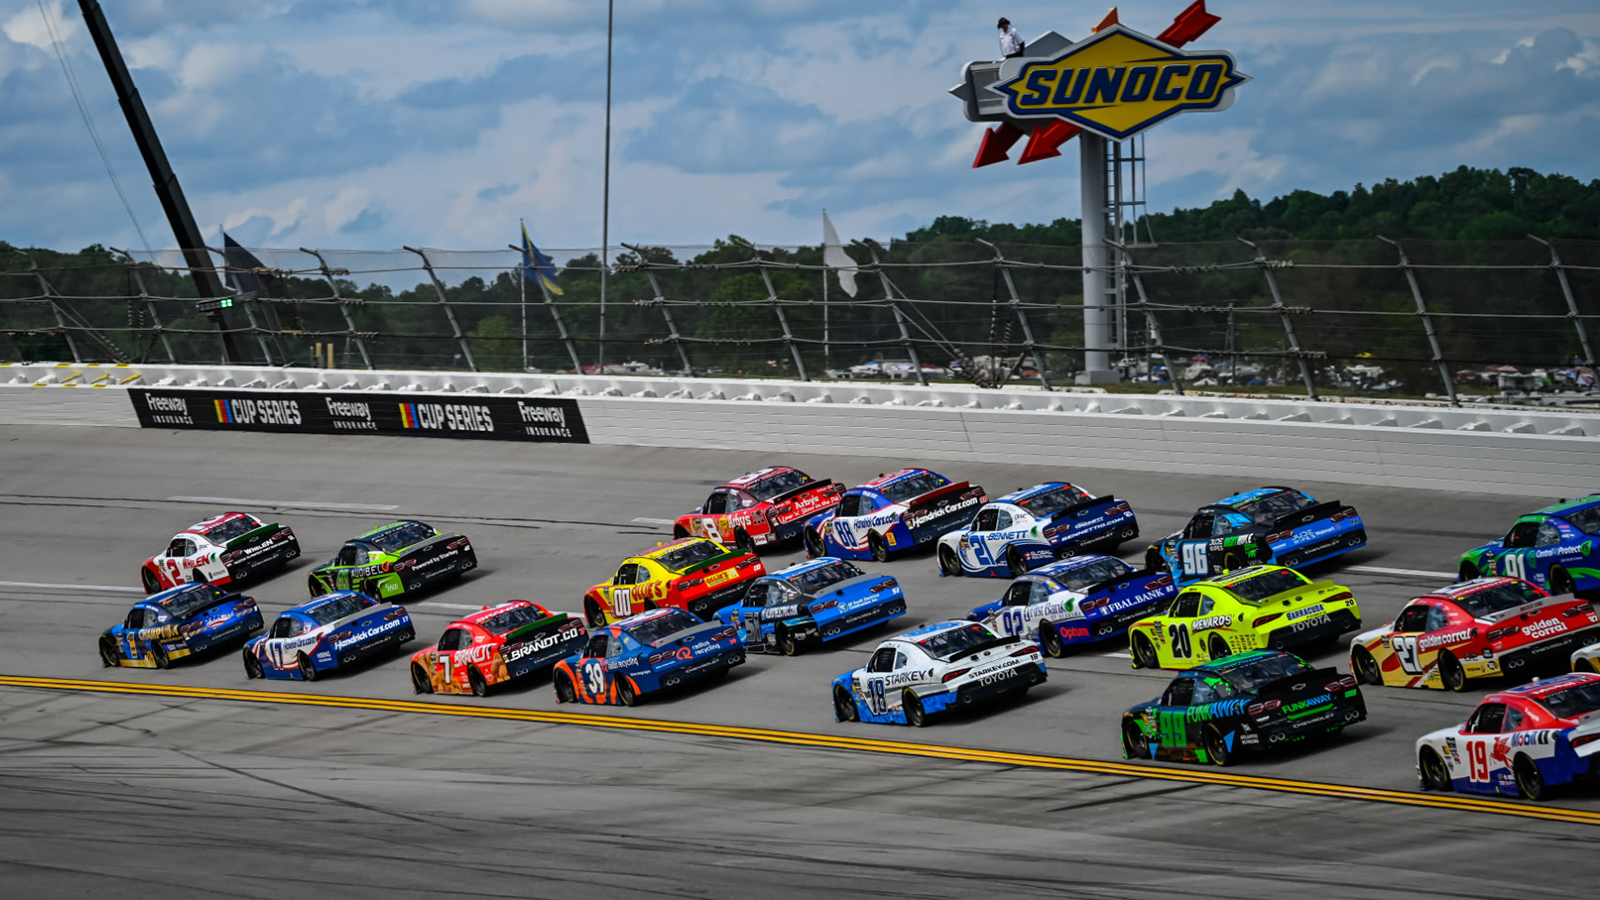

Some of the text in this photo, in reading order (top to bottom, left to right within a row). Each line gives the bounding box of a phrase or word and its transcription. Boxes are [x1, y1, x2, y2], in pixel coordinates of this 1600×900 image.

[1020, 63, 1224, 106] SUNOCO
[145, 393, 187, 415] Freeway
[231, 399, 302, 425] CUP SERIES
[325, 397, 371, 420] Freeway
[517, 401, 566, 427] Freeway
[152, 415, 194, 425] INSURANCE
[333, 420, 379, 431] INSURANCE
[417, 403, 494, 432] CUP SERIES
[525, 427, 572, 438] INSURANCE
[795, 495, 819, 510] Arby's
[912, 497, 978, 528] HendrickCars.com
[702, 517, 723, 543] 8
[728, 511, 752, 530] Arby's
[243, 538, 274, 554] WHELEN
[834, 521, 858, 547] 88
[988, 530, 1029, 540] BENNETT
[969, 535, 996, 565] 21
[1182, 542, 1208, 575] 96
[166, 559, 186, 586] 2
[614, 588, 632, 617] 00
[1286, 604, 1325, 621] BARRACUDA
[1345, 599, 1355, 607] 20
[334, 619, 400, 651] HendrickCars.com
[744, 612, 762, 642] 51
[1060, 626, 1090, 640] Optum
[1192, 614, 1232, 632] MENARDS
[1290, 614, 1331, 632] TOYOTA
[1521, 617, 1560, 636] golden
[1531, 622, 1568, 639] corral
[127, 632, 137, 658] 1
[510, 628, 578, 661] BRANDT.CO
[691, 641, 711, 650] radius
[695, 643, 721, 656] recycling
[1168, 622, 1192, 660] 20
[1419, 627, 1473, 652] golden corral
[269, 642, 284, 670] 17
[454, 643, 498, 668] BRANDT
[1030, 653, 1039, 661] 18
[1392, 635, 1423, 675] 27
[439, 655, 450, 684] 7
[585, 663, 604, 694] 39
[885, 670, 927, 686] STARKEY
[968, 659, 1020, 679] STARKEY.COM
[977, 668, 1018, 687] TOYOTA
[867, 677, 888, 715] 18
[1281, 693, 1331, 714] FUNKAWAY
[1186, 699, 1252, 723] FUNKAWAY
[1293, 713, 1334, 729] CHEVROLET
[1160, 710, 1187, 747] 99
[1511, 731, 1538, 747] Mobil
[1466, 741, 1490, 783] 19
